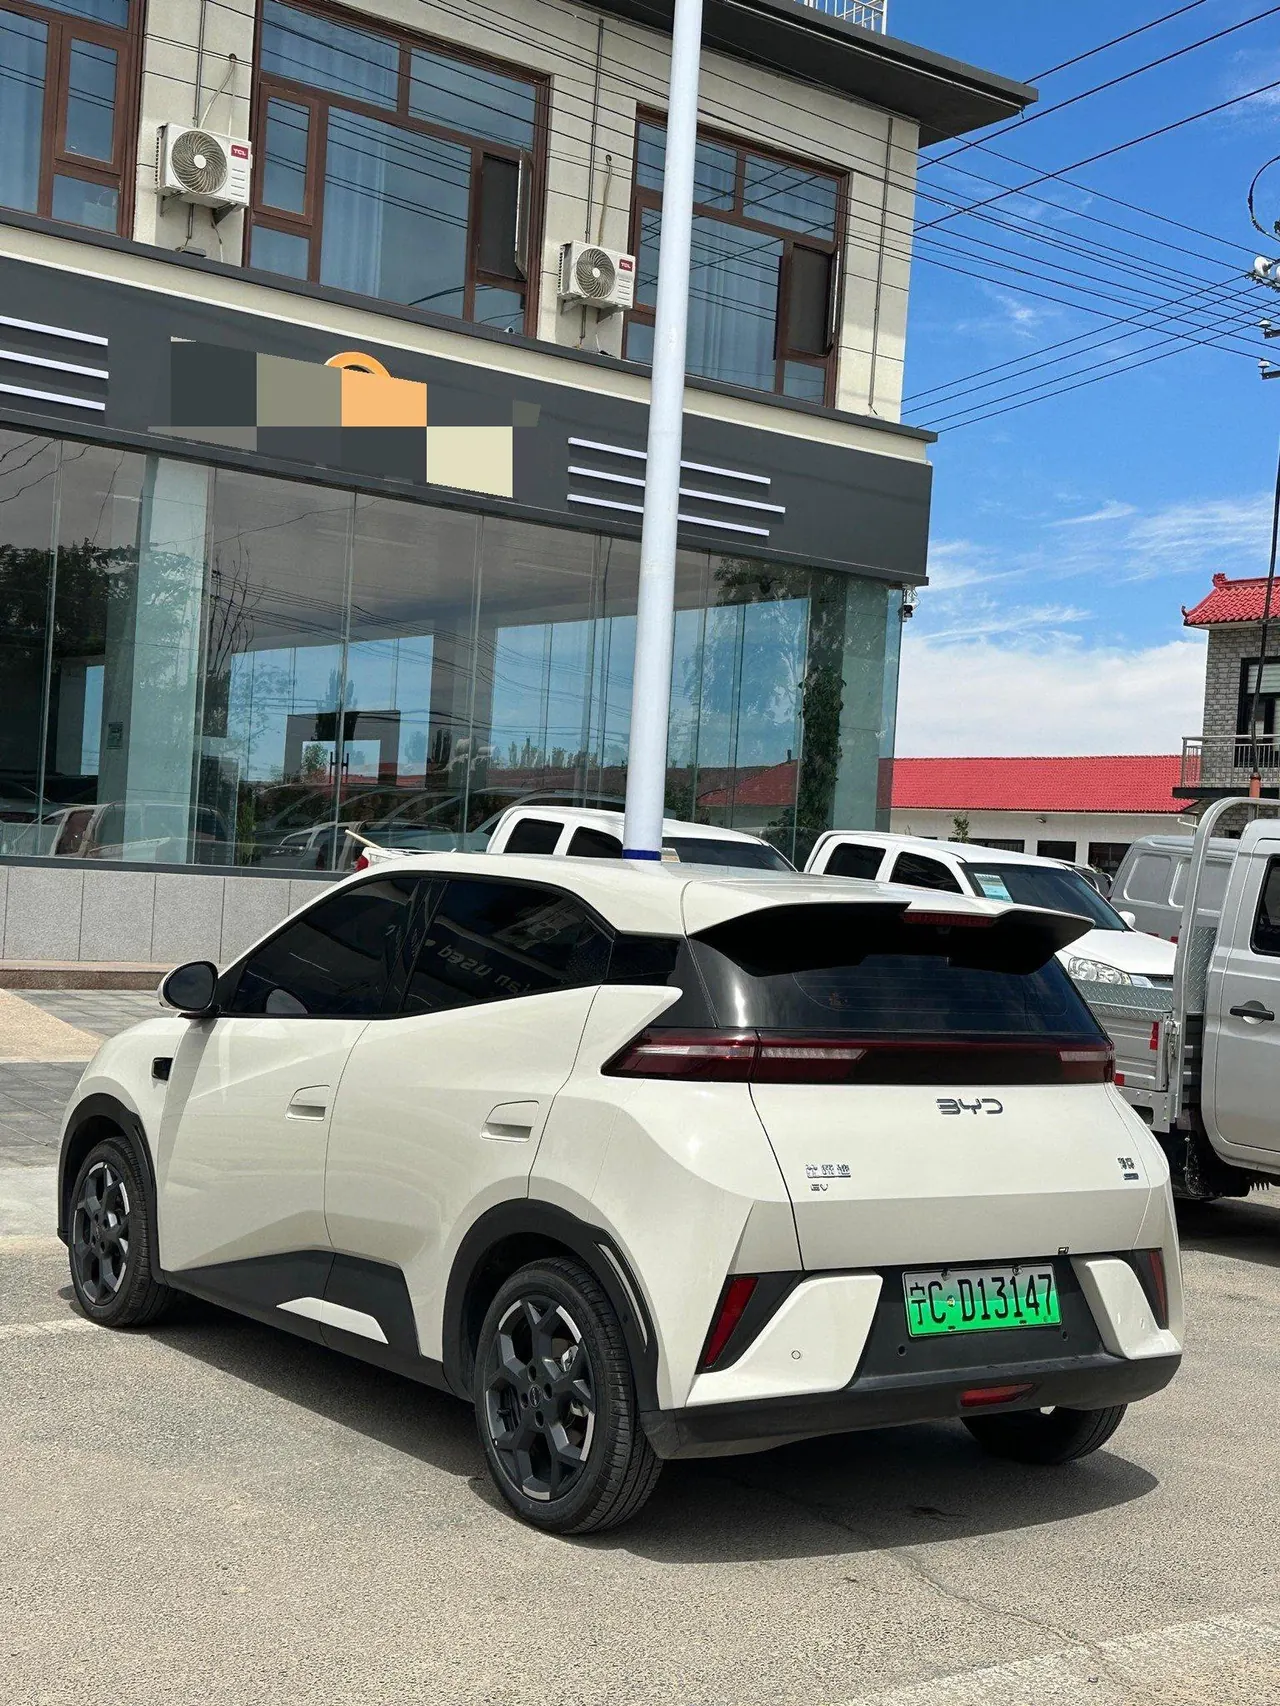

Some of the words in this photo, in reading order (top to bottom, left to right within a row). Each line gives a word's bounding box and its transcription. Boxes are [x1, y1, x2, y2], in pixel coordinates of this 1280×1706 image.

[233, 148, 247, 156] TCL
[936, 1098, 1003, 1114] BYD
[811, 1183, 829, 1191] EV
[957, 1274, 1052, 1321] D13147
